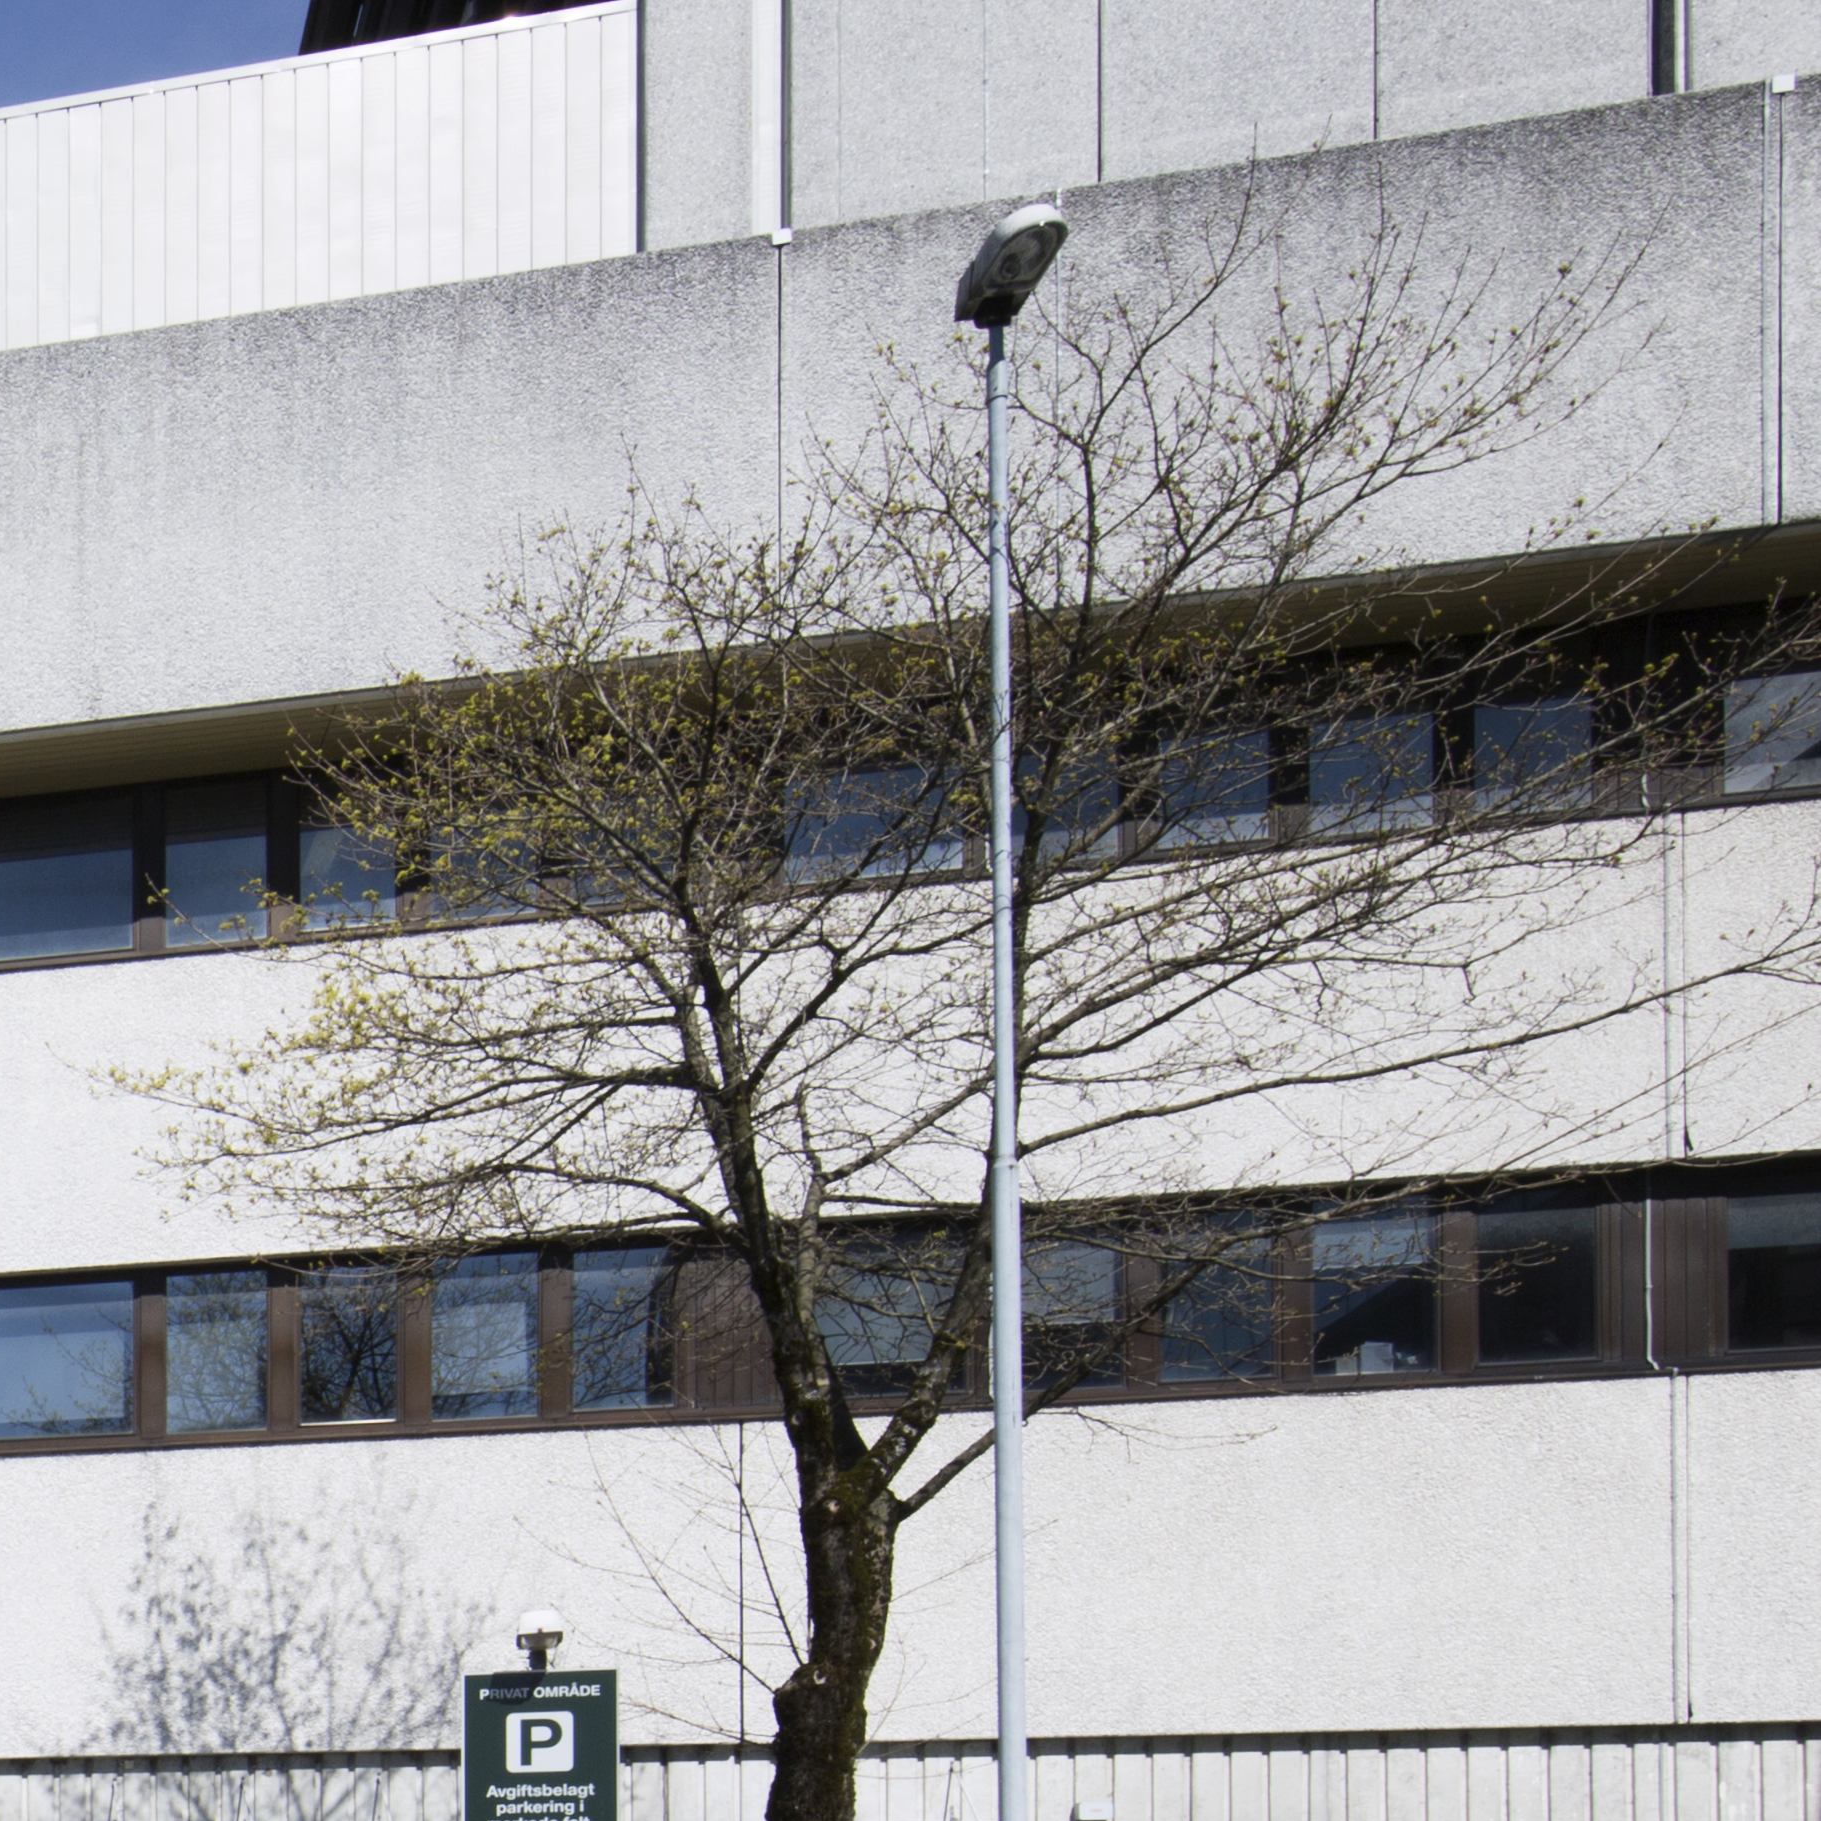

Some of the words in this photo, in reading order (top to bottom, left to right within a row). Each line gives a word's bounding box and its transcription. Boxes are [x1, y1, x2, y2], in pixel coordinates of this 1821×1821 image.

[479, 1687, 530, 1701] PRIVAT
[533, 1682, 601, 1698] OMRÅDE
[520, 1718, 563, 1766] P
[486, 1783, 596, 1800] Avgiftsbelagt
[496, 1800, 575, 1816] parkering
[579, 1799, 584, 1813] i
